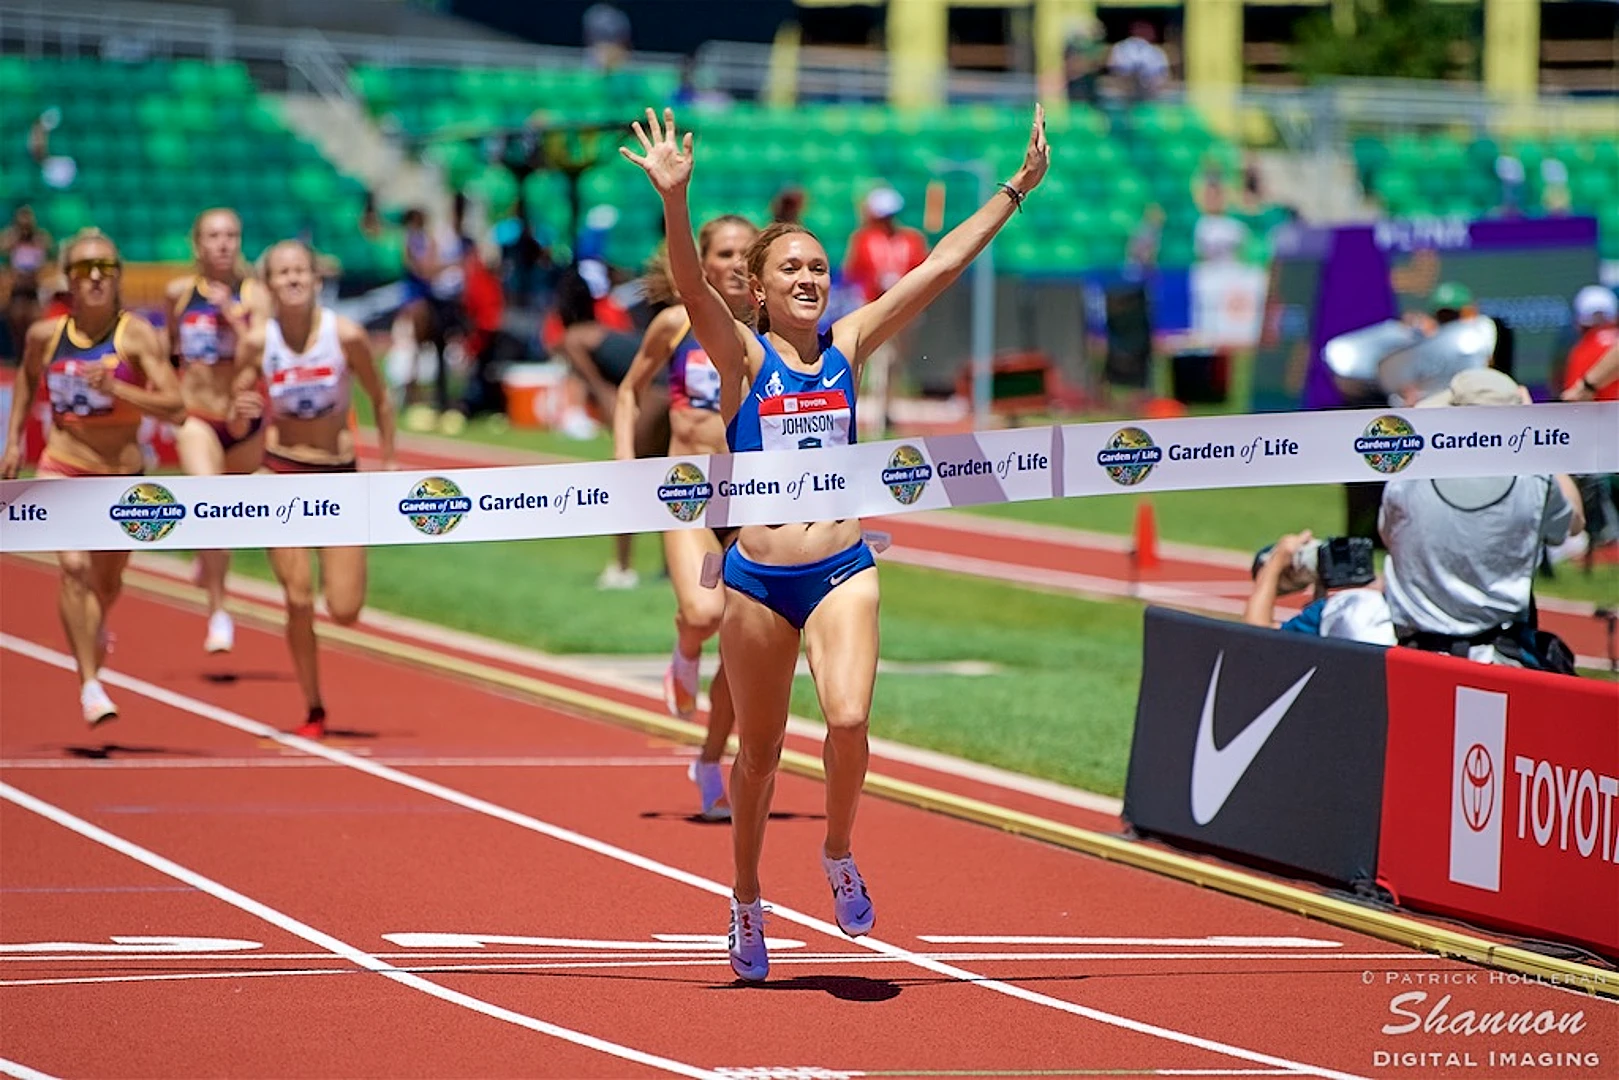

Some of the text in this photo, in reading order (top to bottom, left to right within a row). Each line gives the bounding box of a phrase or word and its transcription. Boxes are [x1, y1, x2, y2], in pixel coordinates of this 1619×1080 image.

[781, 414, 835, 435] JOHNSON
[1169, 435, 1299, 464] Garden of Life
[1431, 426, 1571, 454] Garden of Life
[937, 452, 1048, 479] Garden of Life
[717, 472, 846, 500] Garden of Life
[8, 504, 48, 521] Life
[194, 497, 341, 524] Garden of Life
[479, 487, 609, 514] Garden of Life
[1515, 755, 1619, 864] TOYOT
